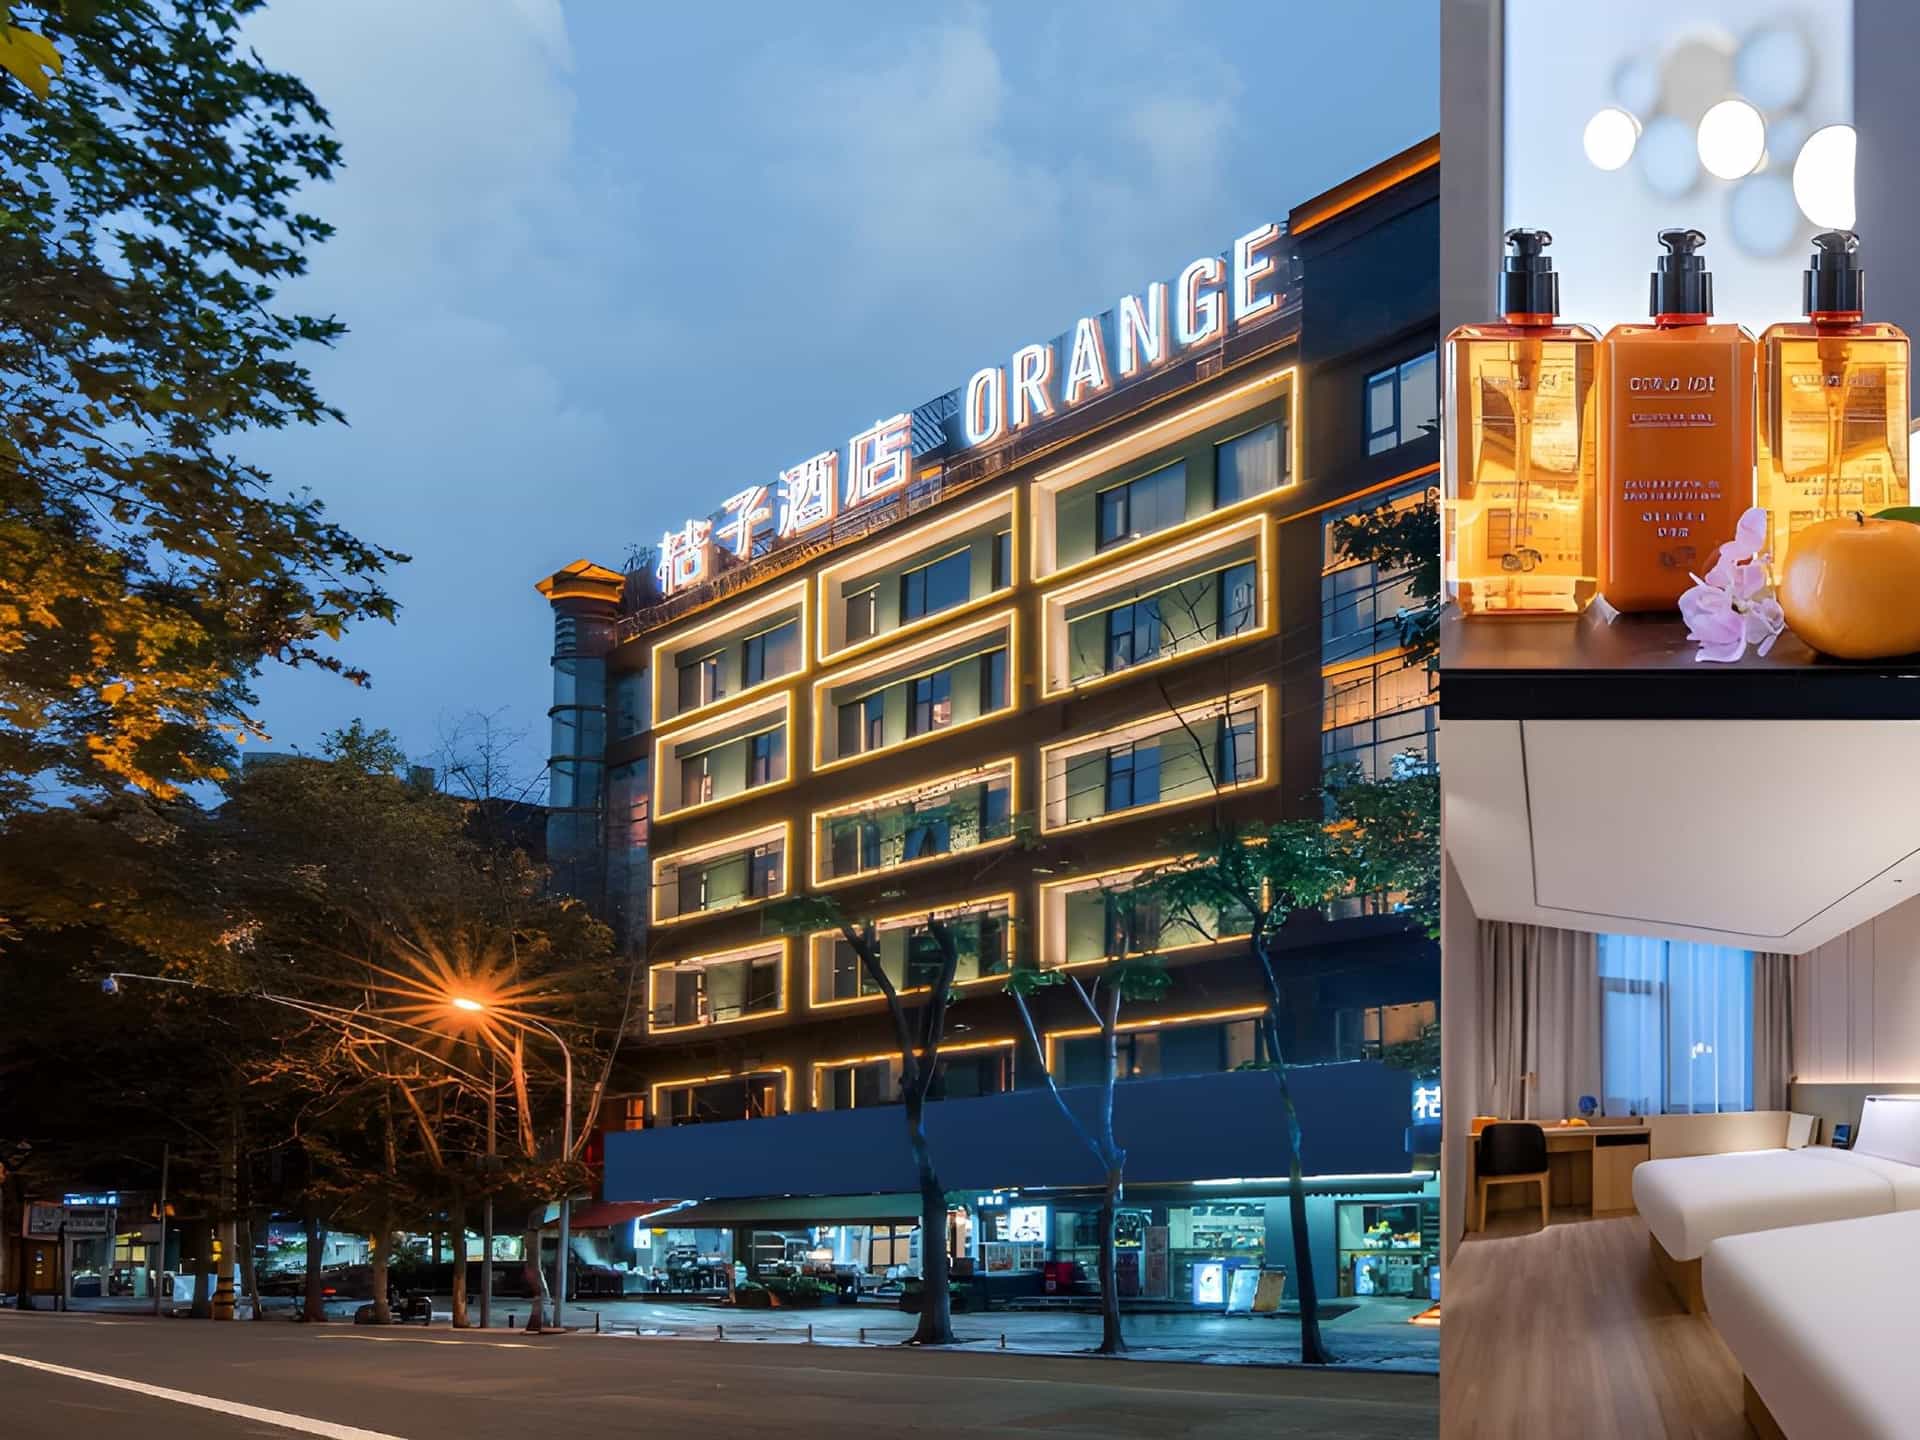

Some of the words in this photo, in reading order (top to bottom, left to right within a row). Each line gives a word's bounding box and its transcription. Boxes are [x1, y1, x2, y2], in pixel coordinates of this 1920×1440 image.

[656, 413, 913, 595] 桔子酒店
[964, 223, 1284, 447] ORANGE
